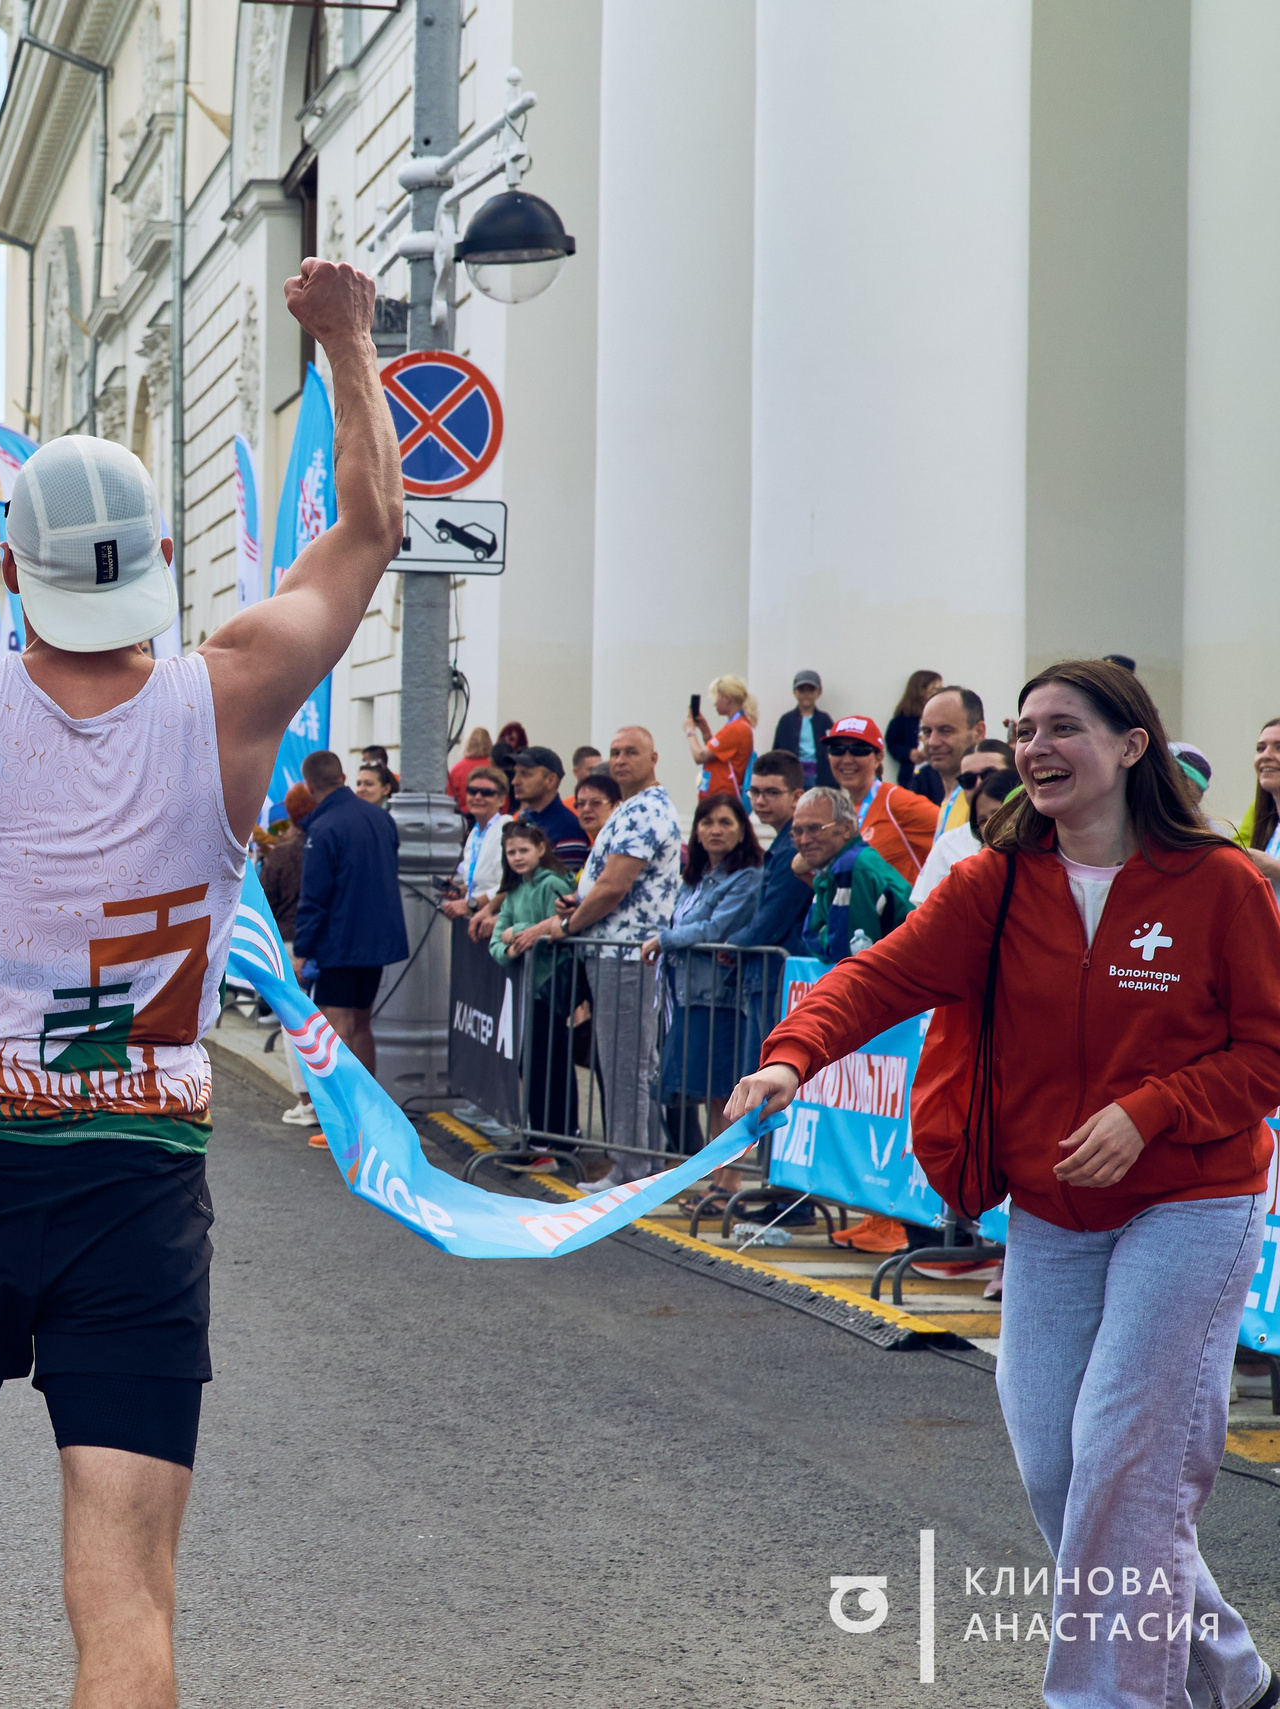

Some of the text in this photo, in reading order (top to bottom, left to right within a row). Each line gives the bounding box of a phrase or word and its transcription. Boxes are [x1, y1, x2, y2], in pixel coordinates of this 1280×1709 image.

[1109, 965, 1180, 983] Волонтеры
[1118, 980, 1169, 992] медики
[453, 1000, 494, 1046] КЛАСТЕР
[838, 1052, 908, 1119] КУЛЬТУРУ
